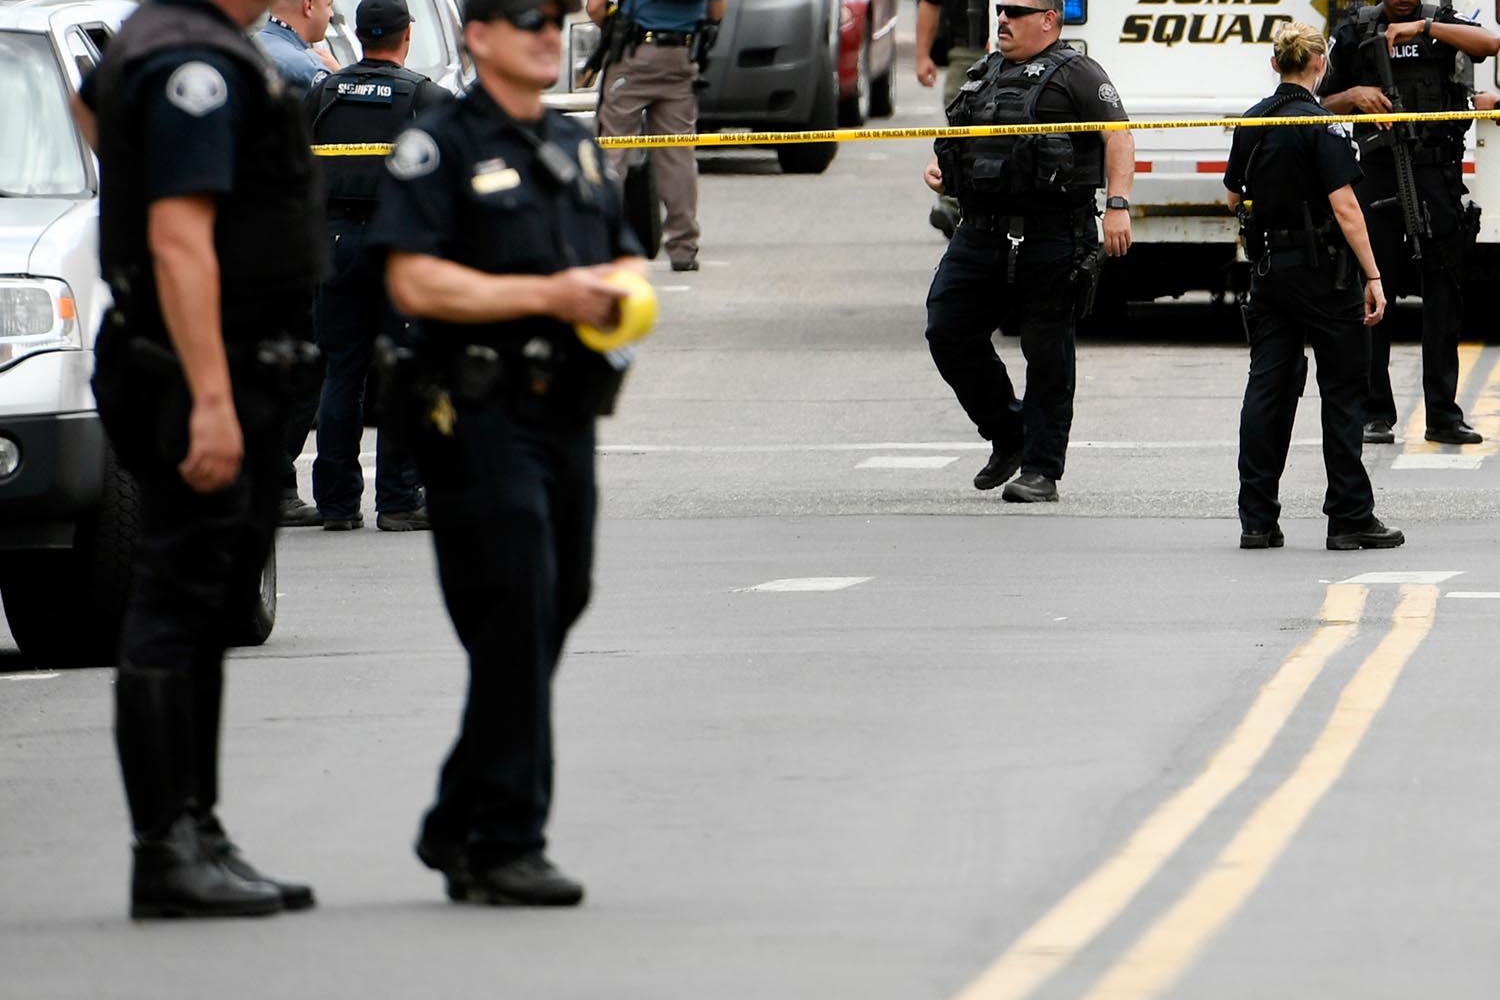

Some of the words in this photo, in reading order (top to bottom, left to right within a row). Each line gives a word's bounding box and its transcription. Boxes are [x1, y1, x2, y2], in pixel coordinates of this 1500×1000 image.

[1119, 14, 1293, 47] SQUAD
[337, 83, 376, 96] SHERIFF
[377, 85, 392, 97] K9
[882, 130, 904, 138] POLICIA
[948, 128, 970, 136] CRUZAR
